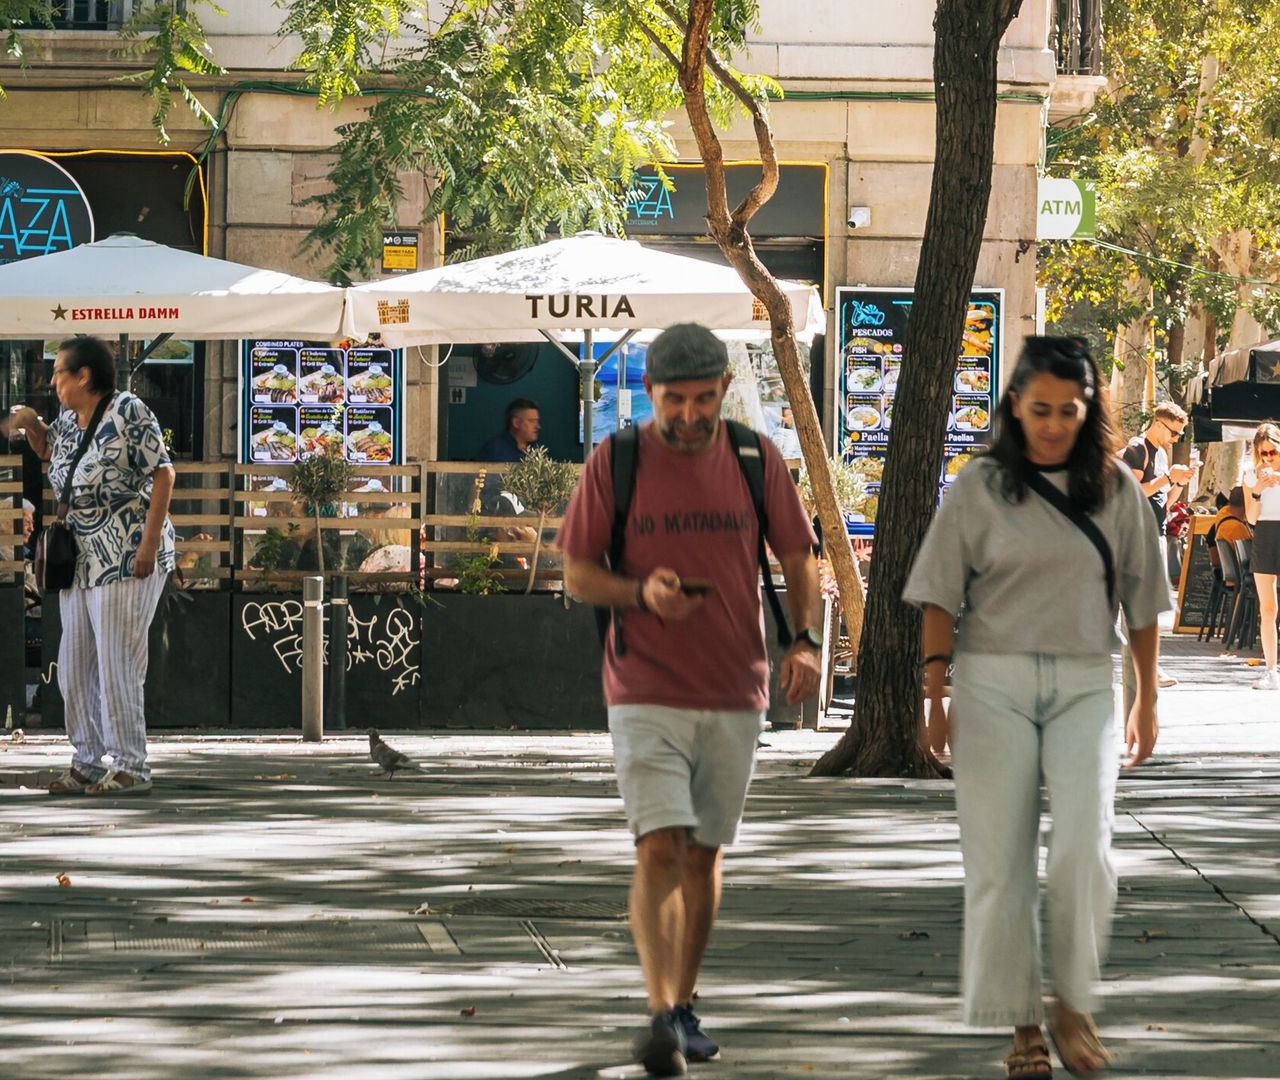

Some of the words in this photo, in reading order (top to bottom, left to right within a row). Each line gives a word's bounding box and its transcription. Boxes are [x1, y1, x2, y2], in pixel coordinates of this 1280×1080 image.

[1040, 200, 1081, 215] ATM
[525, 294, 636, 319] TURIA
[71, 307, 134, 321] ESTRELLA
[138, 307, 179, 319] DAMM
[852, 328, 894, 337] PESCADOS
[851, 346, 868, 354] FISH
[948, 433, 975, 442] Paellas
[633, 514, 656, 537] NO
